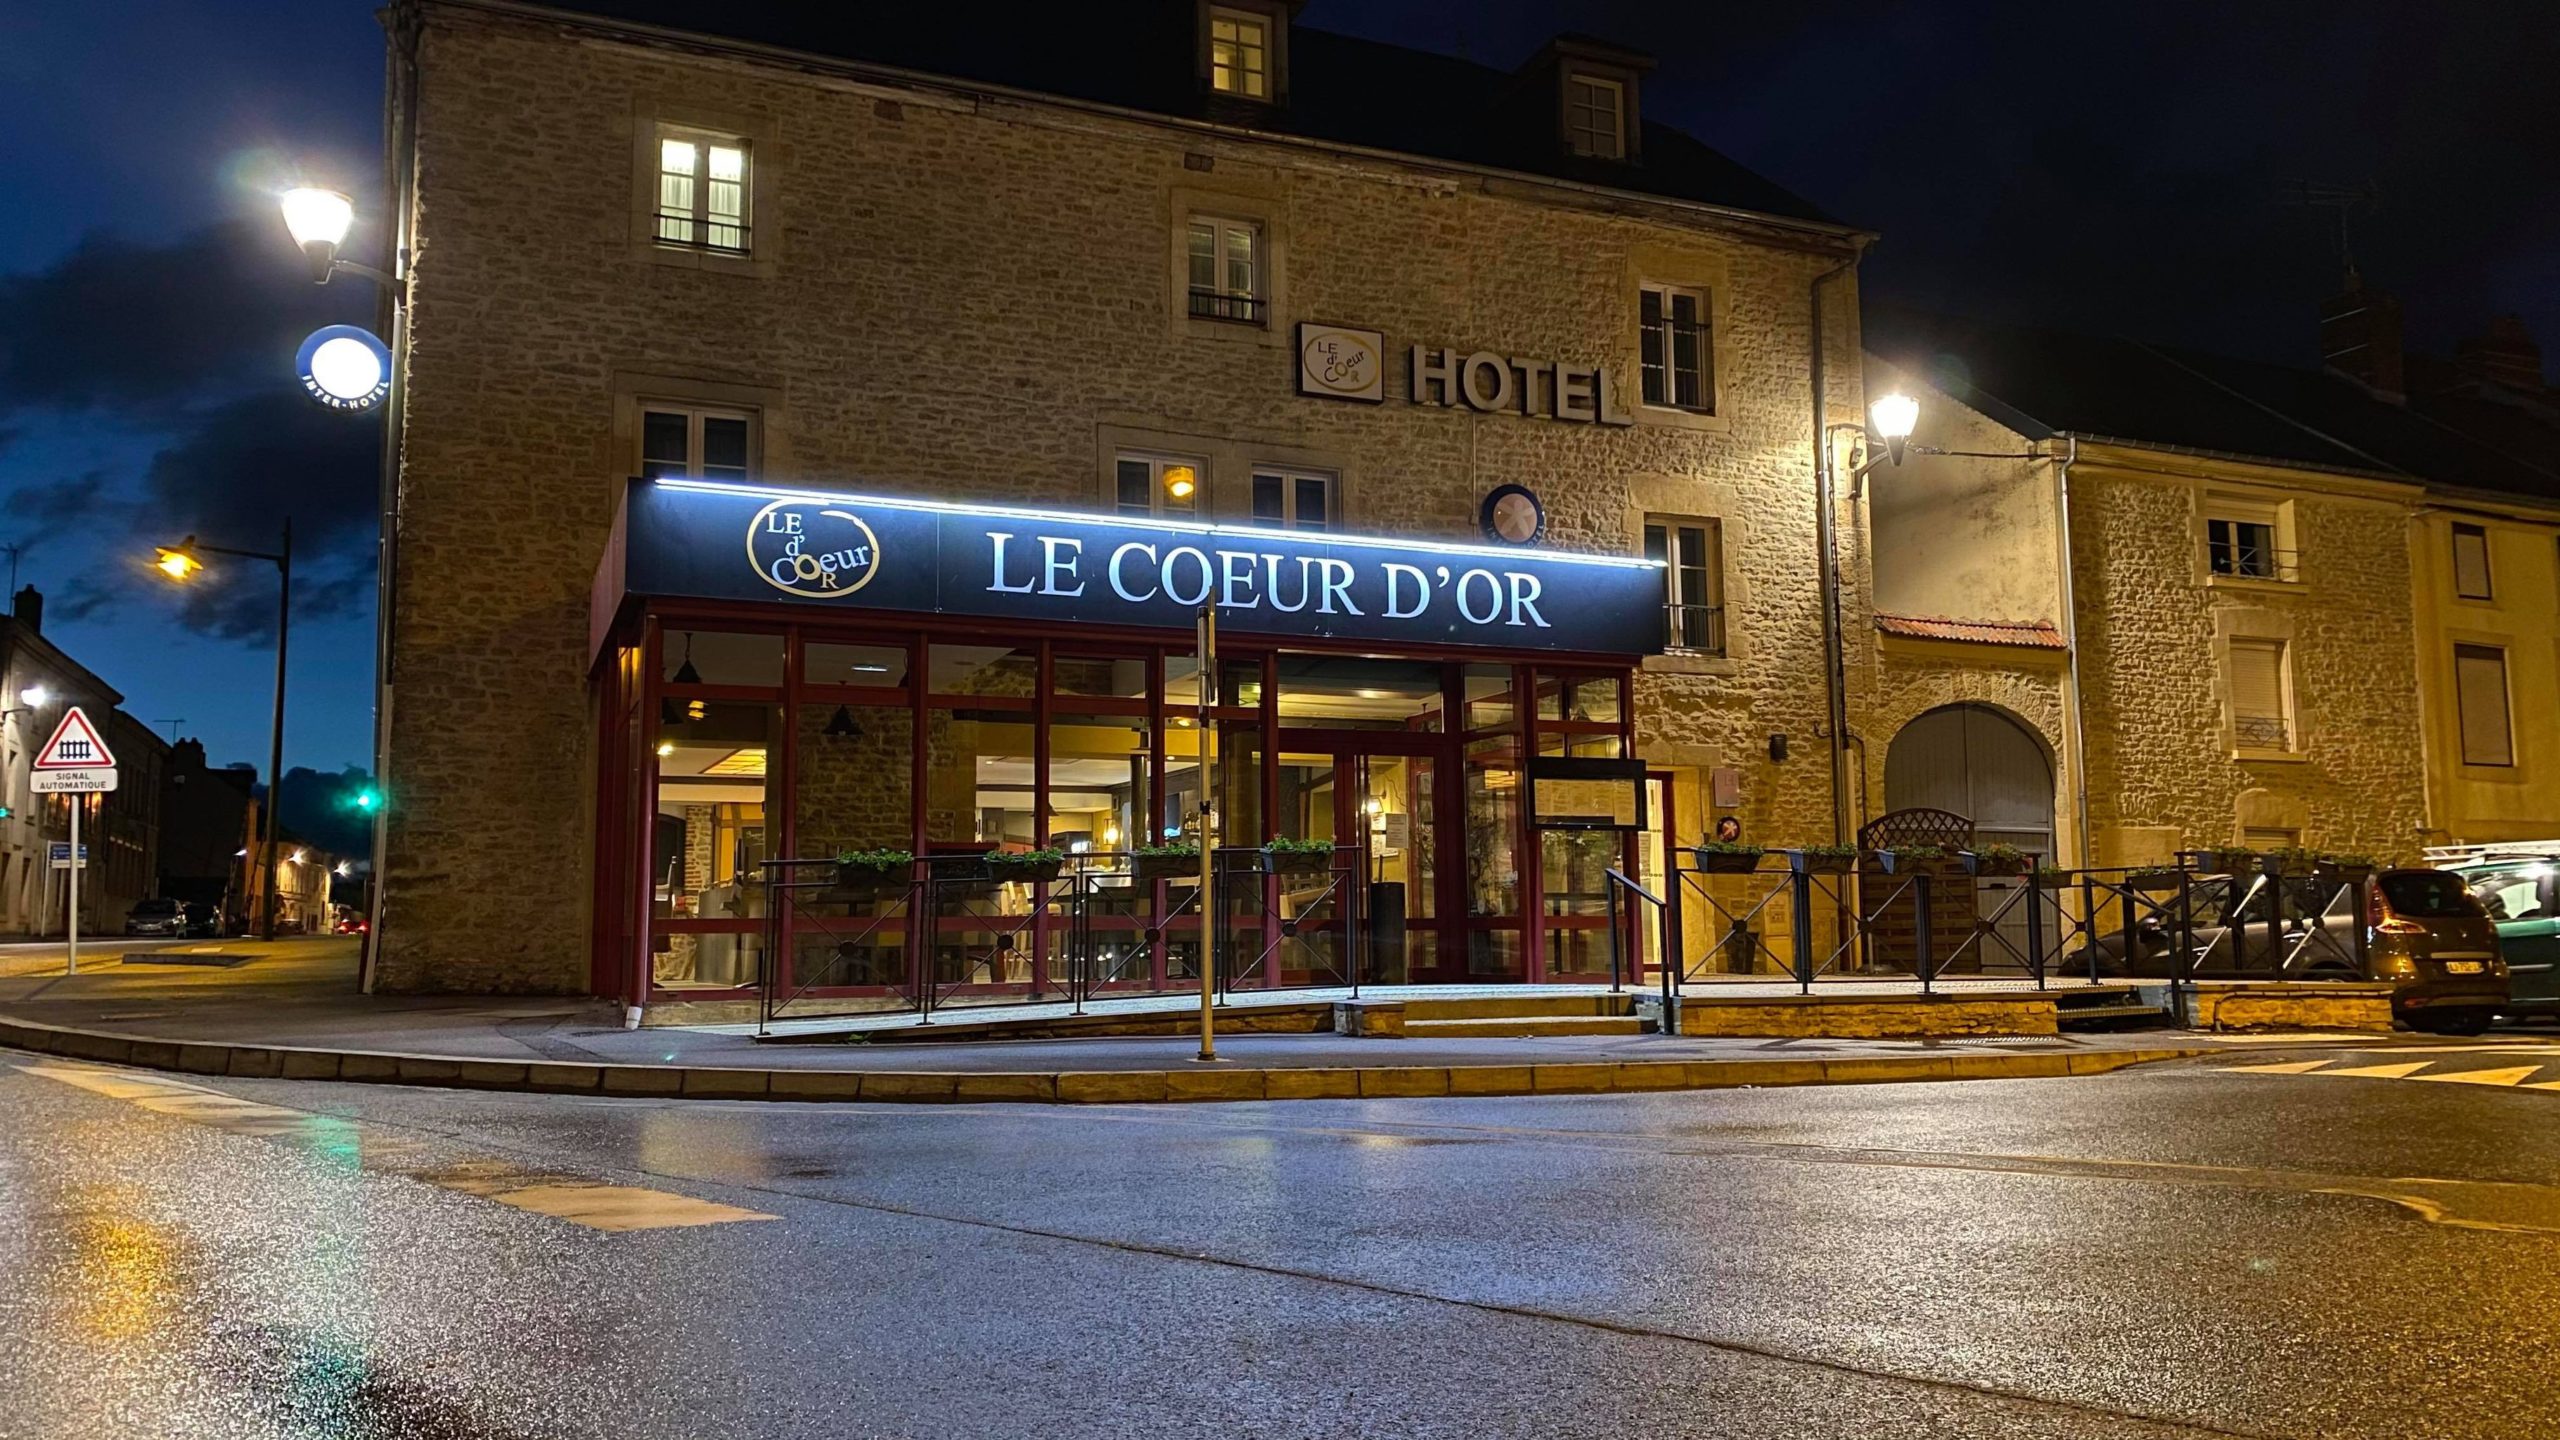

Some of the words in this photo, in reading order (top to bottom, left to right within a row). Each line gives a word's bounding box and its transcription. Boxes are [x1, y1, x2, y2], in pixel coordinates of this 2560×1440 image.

[1318, 341, 1338, 354] LE
[302, 375, 389, 409] INTER-HOTEL
[1411, 344, 1634, 426] HOTEL
[766, 511, 803, 534] LE
[985, 532, 1085, 597] LE
[1107, 541, 1365, 616] COEUR
[1380, 562, 1552, 628] D'OR
[39, 781, 107, 790] AUTOMATIQUE
[56, 772, 90, 780] SIGNAL
